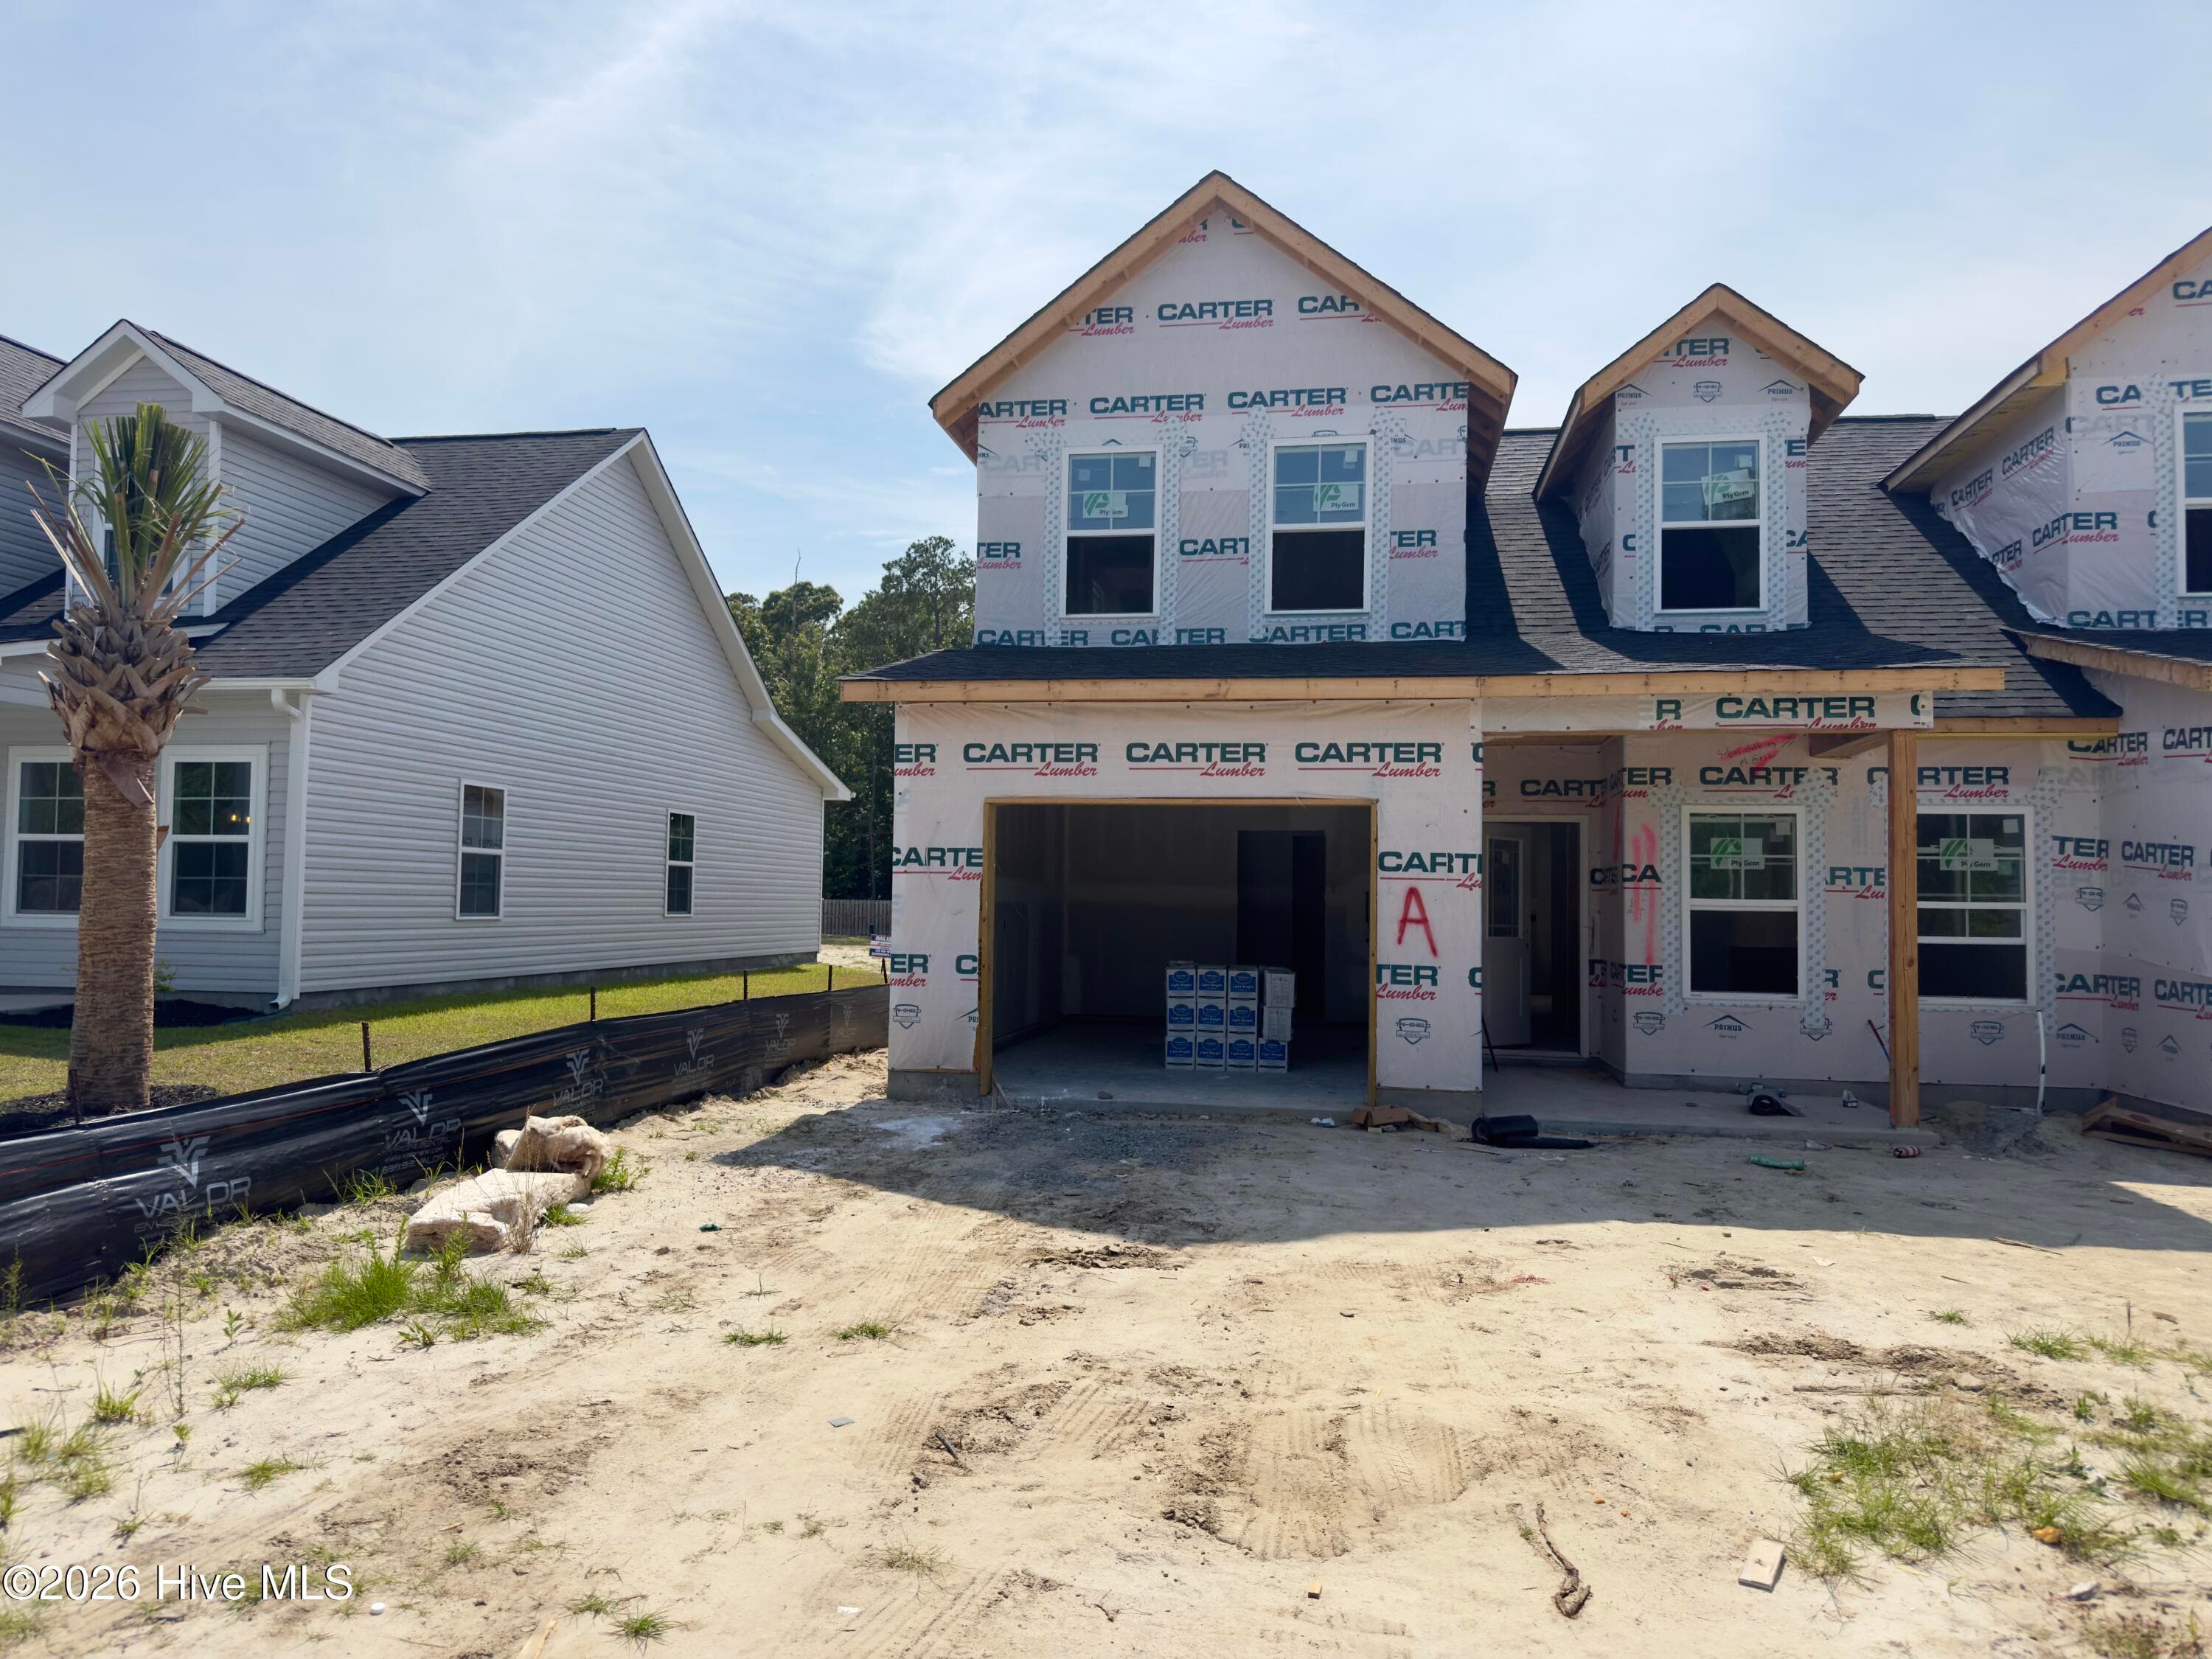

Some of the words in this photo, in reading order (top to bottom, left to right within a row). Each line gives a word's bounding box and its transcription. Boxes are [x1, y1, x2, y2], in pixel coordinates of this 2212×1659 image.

[1158, 299, 1273, 321] CARTER
[1082, 321, 1134, 336] Lumber
[1220, 315, 1273, 330] Lumber
[1672, 354, 1729, 368] Lumber
[1090, 394, 1205, 414] CARTER
[1227, 387, 1346, 408] CARTER
[1291, 403, 1345, 417] Lumber
[2002, 426, 2054, 476] CARTER
[2032, 512, 2118, 548] CARTER
[1716, 695, 1876, 719] CARTER
[963, 743, 1099, 763] CARTER
[1126, 742, 1266, 763] CARTER
[1295, 742, 1441, 763] CARTER
[1034, 762, 1097, 777] Lumber
[1200, 761, 1265, 777] Lumber
[1371, 761, 1441, 778] Lumber
[1944, 782, 2010, 799] Lumber
[2121, 841, 2194, 867] CARTER
[1397, 886, 1439, 959] A
[1376, 982, 1437, 1001] Lumber
[674, 1054, 714, 1077] VALOR
[553, 1078, 603, 1107] VALOR
